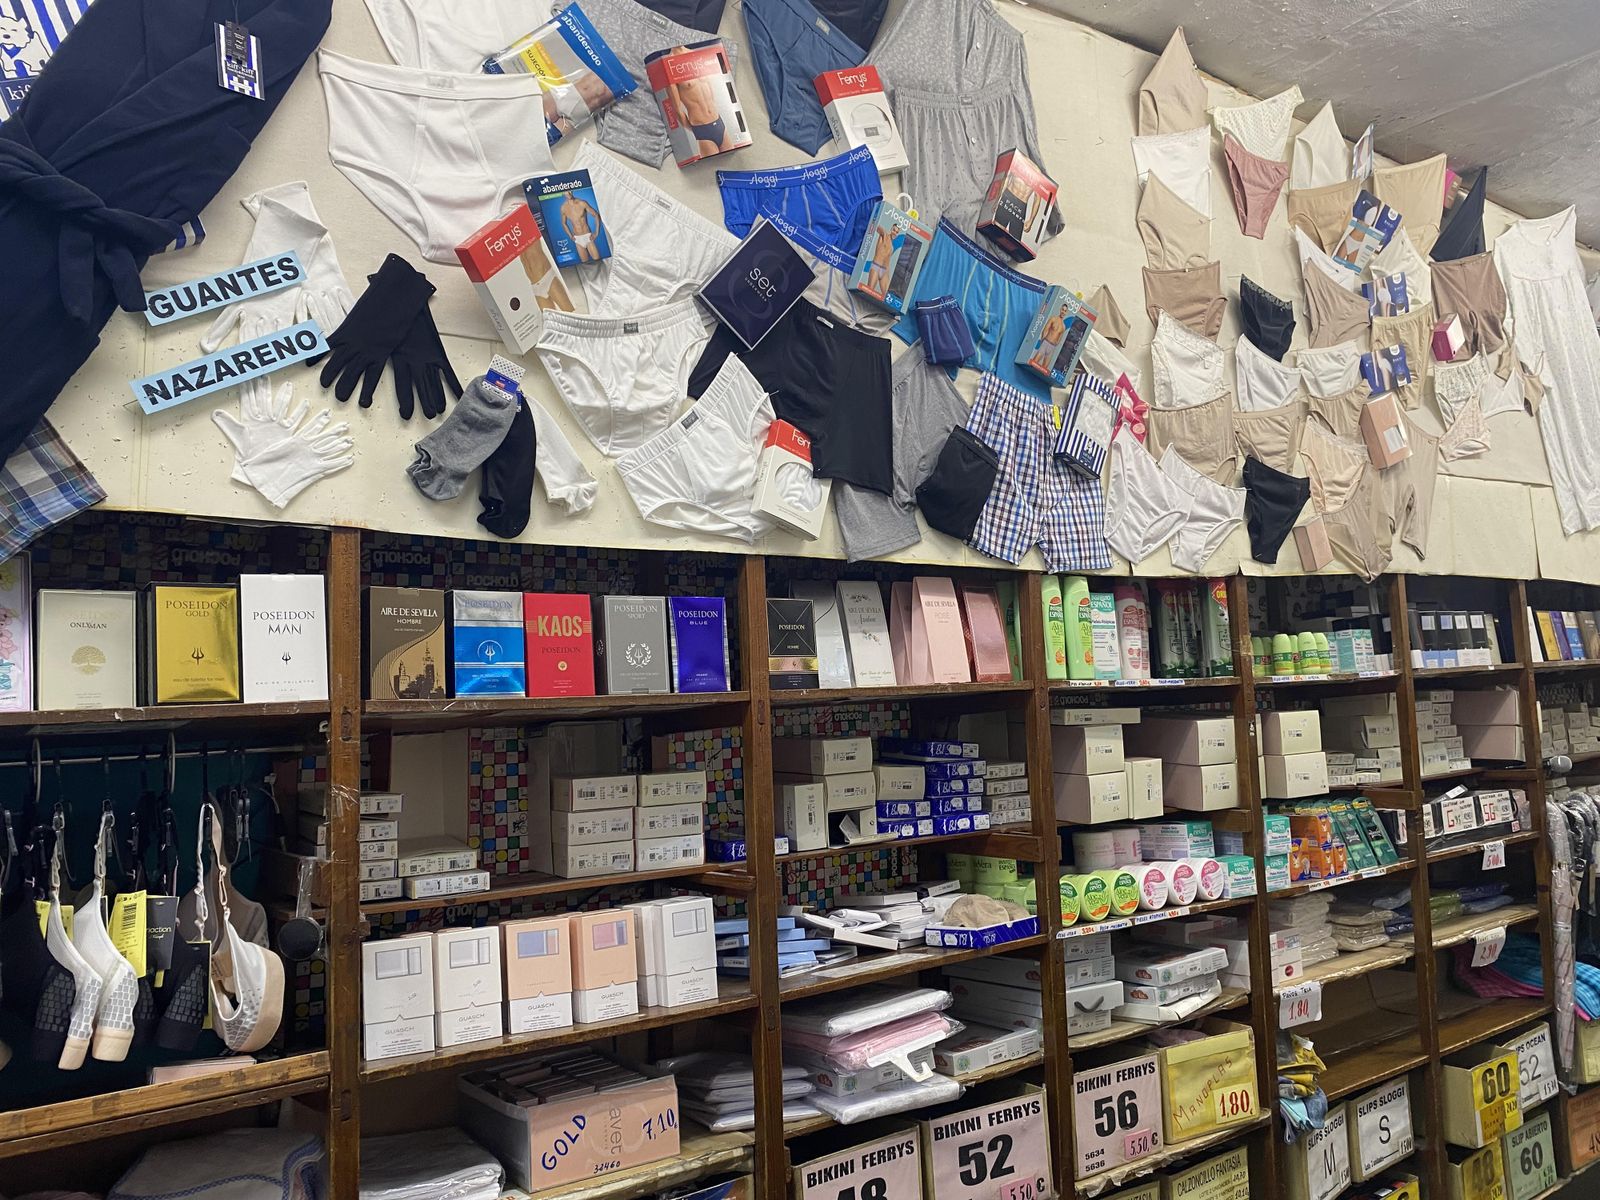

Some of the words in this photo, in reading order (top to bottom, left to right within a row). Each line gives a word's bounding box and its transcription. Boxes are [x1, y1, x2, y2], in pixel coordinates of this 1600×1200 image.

[560, 14, 602, 67] abanderado
[750, 173, 779, 187] sloggi
[801, 164, 829, 180] sloggi
[542, 180, 583, 194] abanderado
[770, 212, 799, 236] sloggi
[884, 207, 912, 231] sloggi
[816, 243, 843, 267] sloggi
[148, 256, 300, 319] GUANTES
[749, 267, 777, 298] set
[1059, 293, 1082, 314] sloggi
[142, 329, 318, 406] NAZARENO
[165, 599, 228, 611] POSEIDON
[184, 609, 210, 618] GOLD
[252, 610, 316, 621] POSEIDON
[380, 607, 398, 616] AIRE
[399, 607, 411, 616] DE
[411, 608, 438, 618] SEVILLA
[464, 599, 513, 609] POSEIDON
[614, 604, 658, 613] POSEIDON
[678, 610, 719, 619] POSEIDON
[267, 623, 302, 636] MAN
[537, 615, 583, 638] KAOS
[541, 646, 581, 654] POSEIDON
[681, 977, 704, 985] GUASCH
[528, 1002, 555, 1011] GUASCH
[600, 991, 624, 1000] GUASCH
[458, 1012, 486, 1022] GUASCH
[384, 1026, 415, 1035] GUASCH
[1526, 1034, 1546, 1049] OCEAN
[1076, 1073, 1112, 1094] BIKINI
[1116, 1061, 1156, 1083] FERRYS
[1520, 1054, 1542, 1086] 52
[1481, 1061, 1511, 1105] 60
[1094, 1089, 1139, 1138] 56
[1358, 1100, 1377, 1118] SLIPS
[1379, 1087, 1405, 1107] SLOGGI
[933, 1115, 983, 1142] BIKINI
[988, 1100, 1041, 1127] FERRYS
[1307, 1131, 1324, 1151] SLIPS
[1324, 1114, 1345, 1138] SLOGGI
[1378, 1115, 1391, 1145] S
[541, 1113, 587, 1171] GOLD
[1511, 1133, 1525, 1148] SLIP
[1525, 1120, 1548, 1141] ABIERTO
[806, 1158, 855, 1189] BIKINI
[862, 1139, 915, 1170] FERRYS
[958, 1133, 1015, 1187] 52
[1085, 1148, 1105, 1161] 5634
[1085, 1160, 1106, 1172] 5636
[1323, 1142, 1337, 1180] M
[1520, 1141, 1544, 1176] 60
[1177, 1166, 1216, 1197] CALZONCILLO
[1216, 1153, 1242, 1178] FANTASIA
